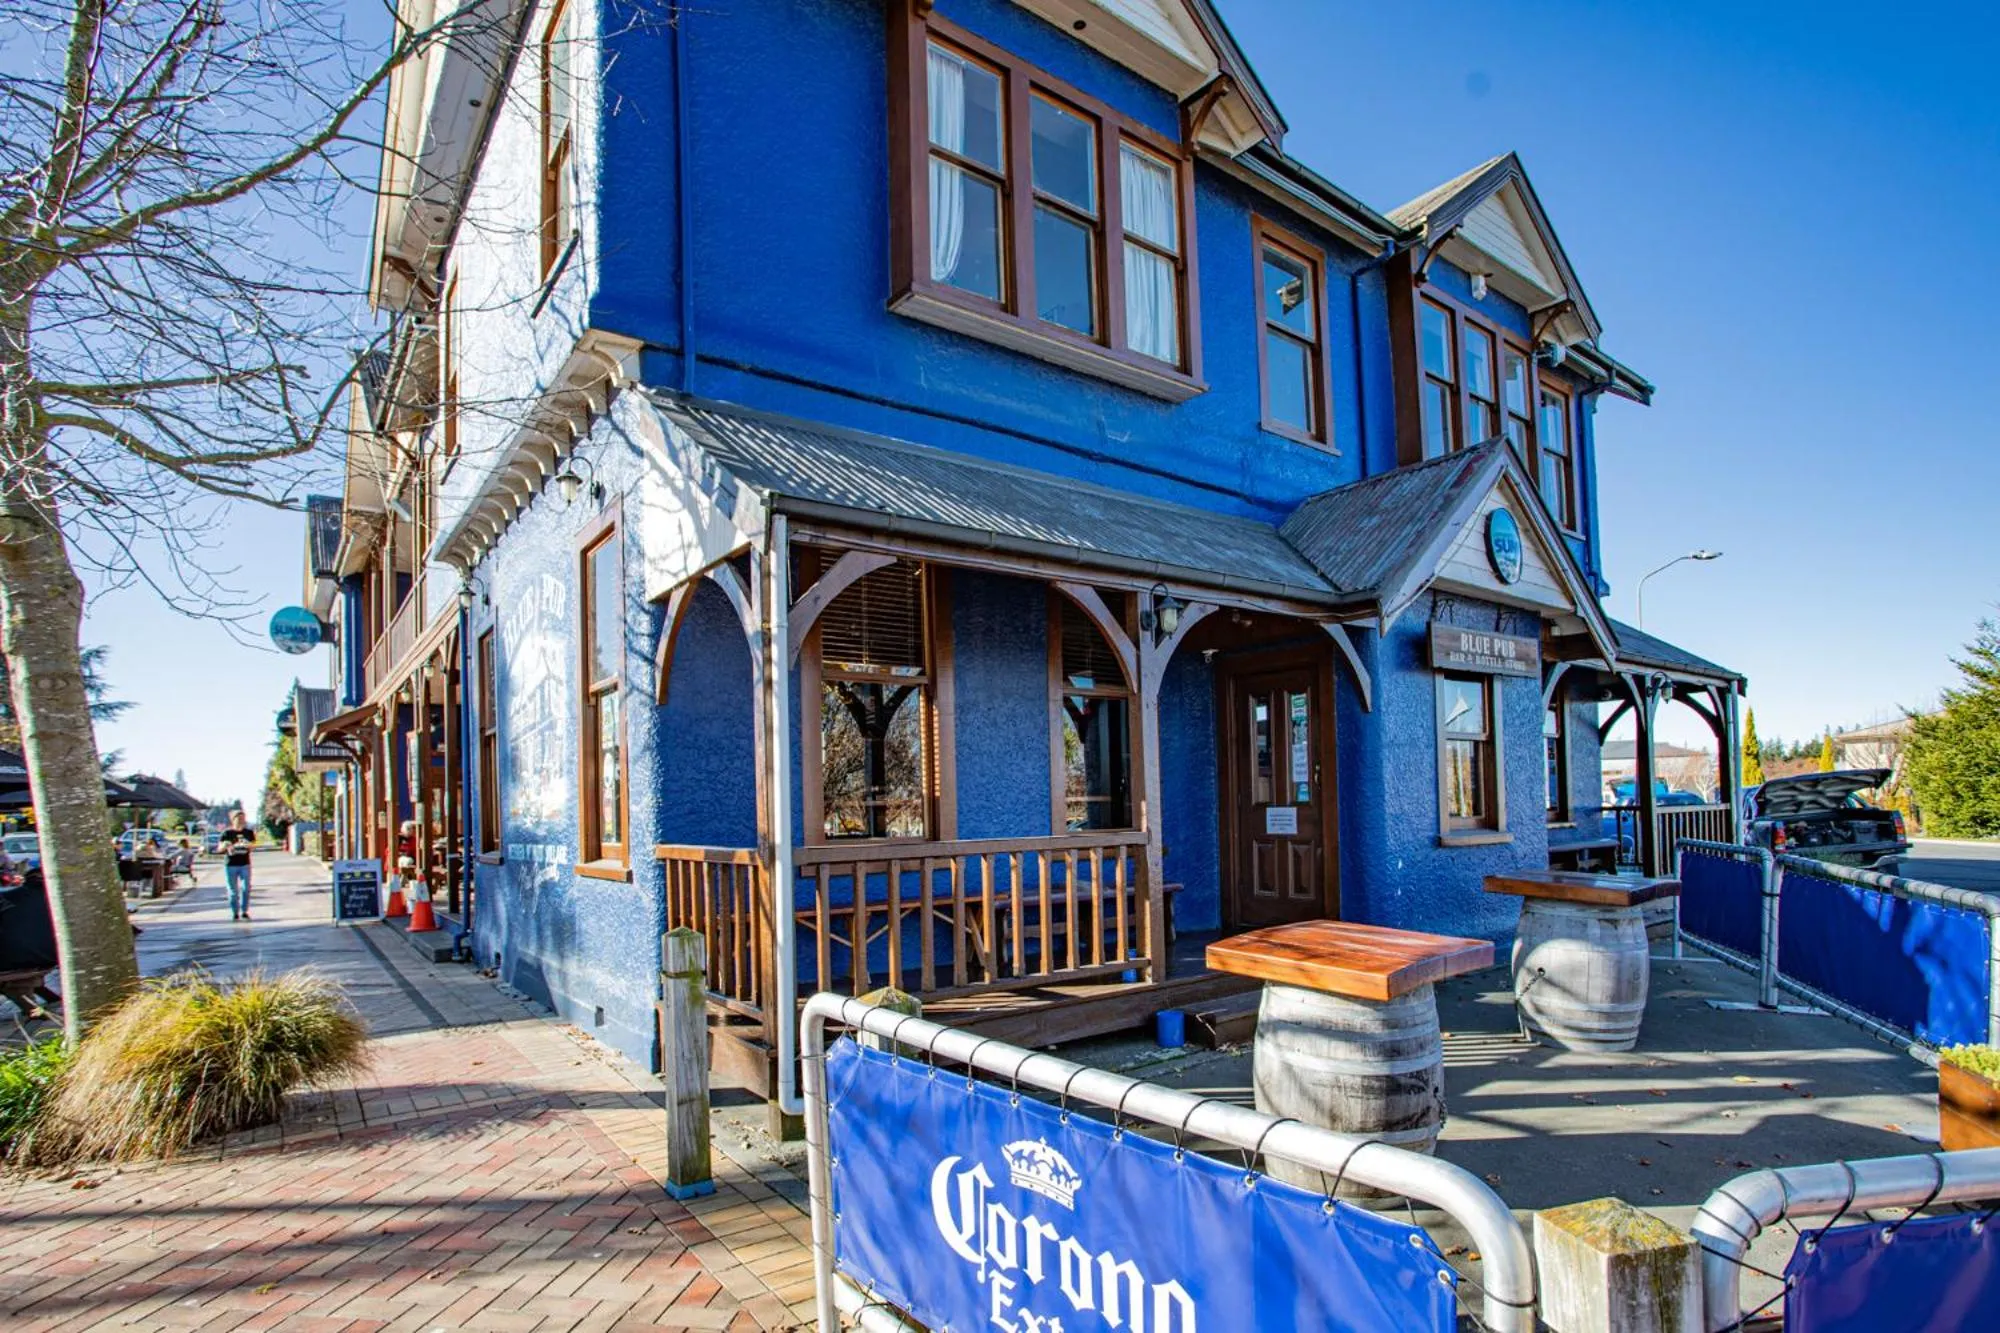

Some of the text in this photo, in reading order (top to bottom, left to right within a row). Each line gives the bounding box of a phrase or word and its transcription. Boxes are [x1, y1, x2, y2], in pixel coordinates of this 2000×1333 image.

[542, 574, 565, 620] PUB
[1461, 633, 1516, 658] BLUE PUB
